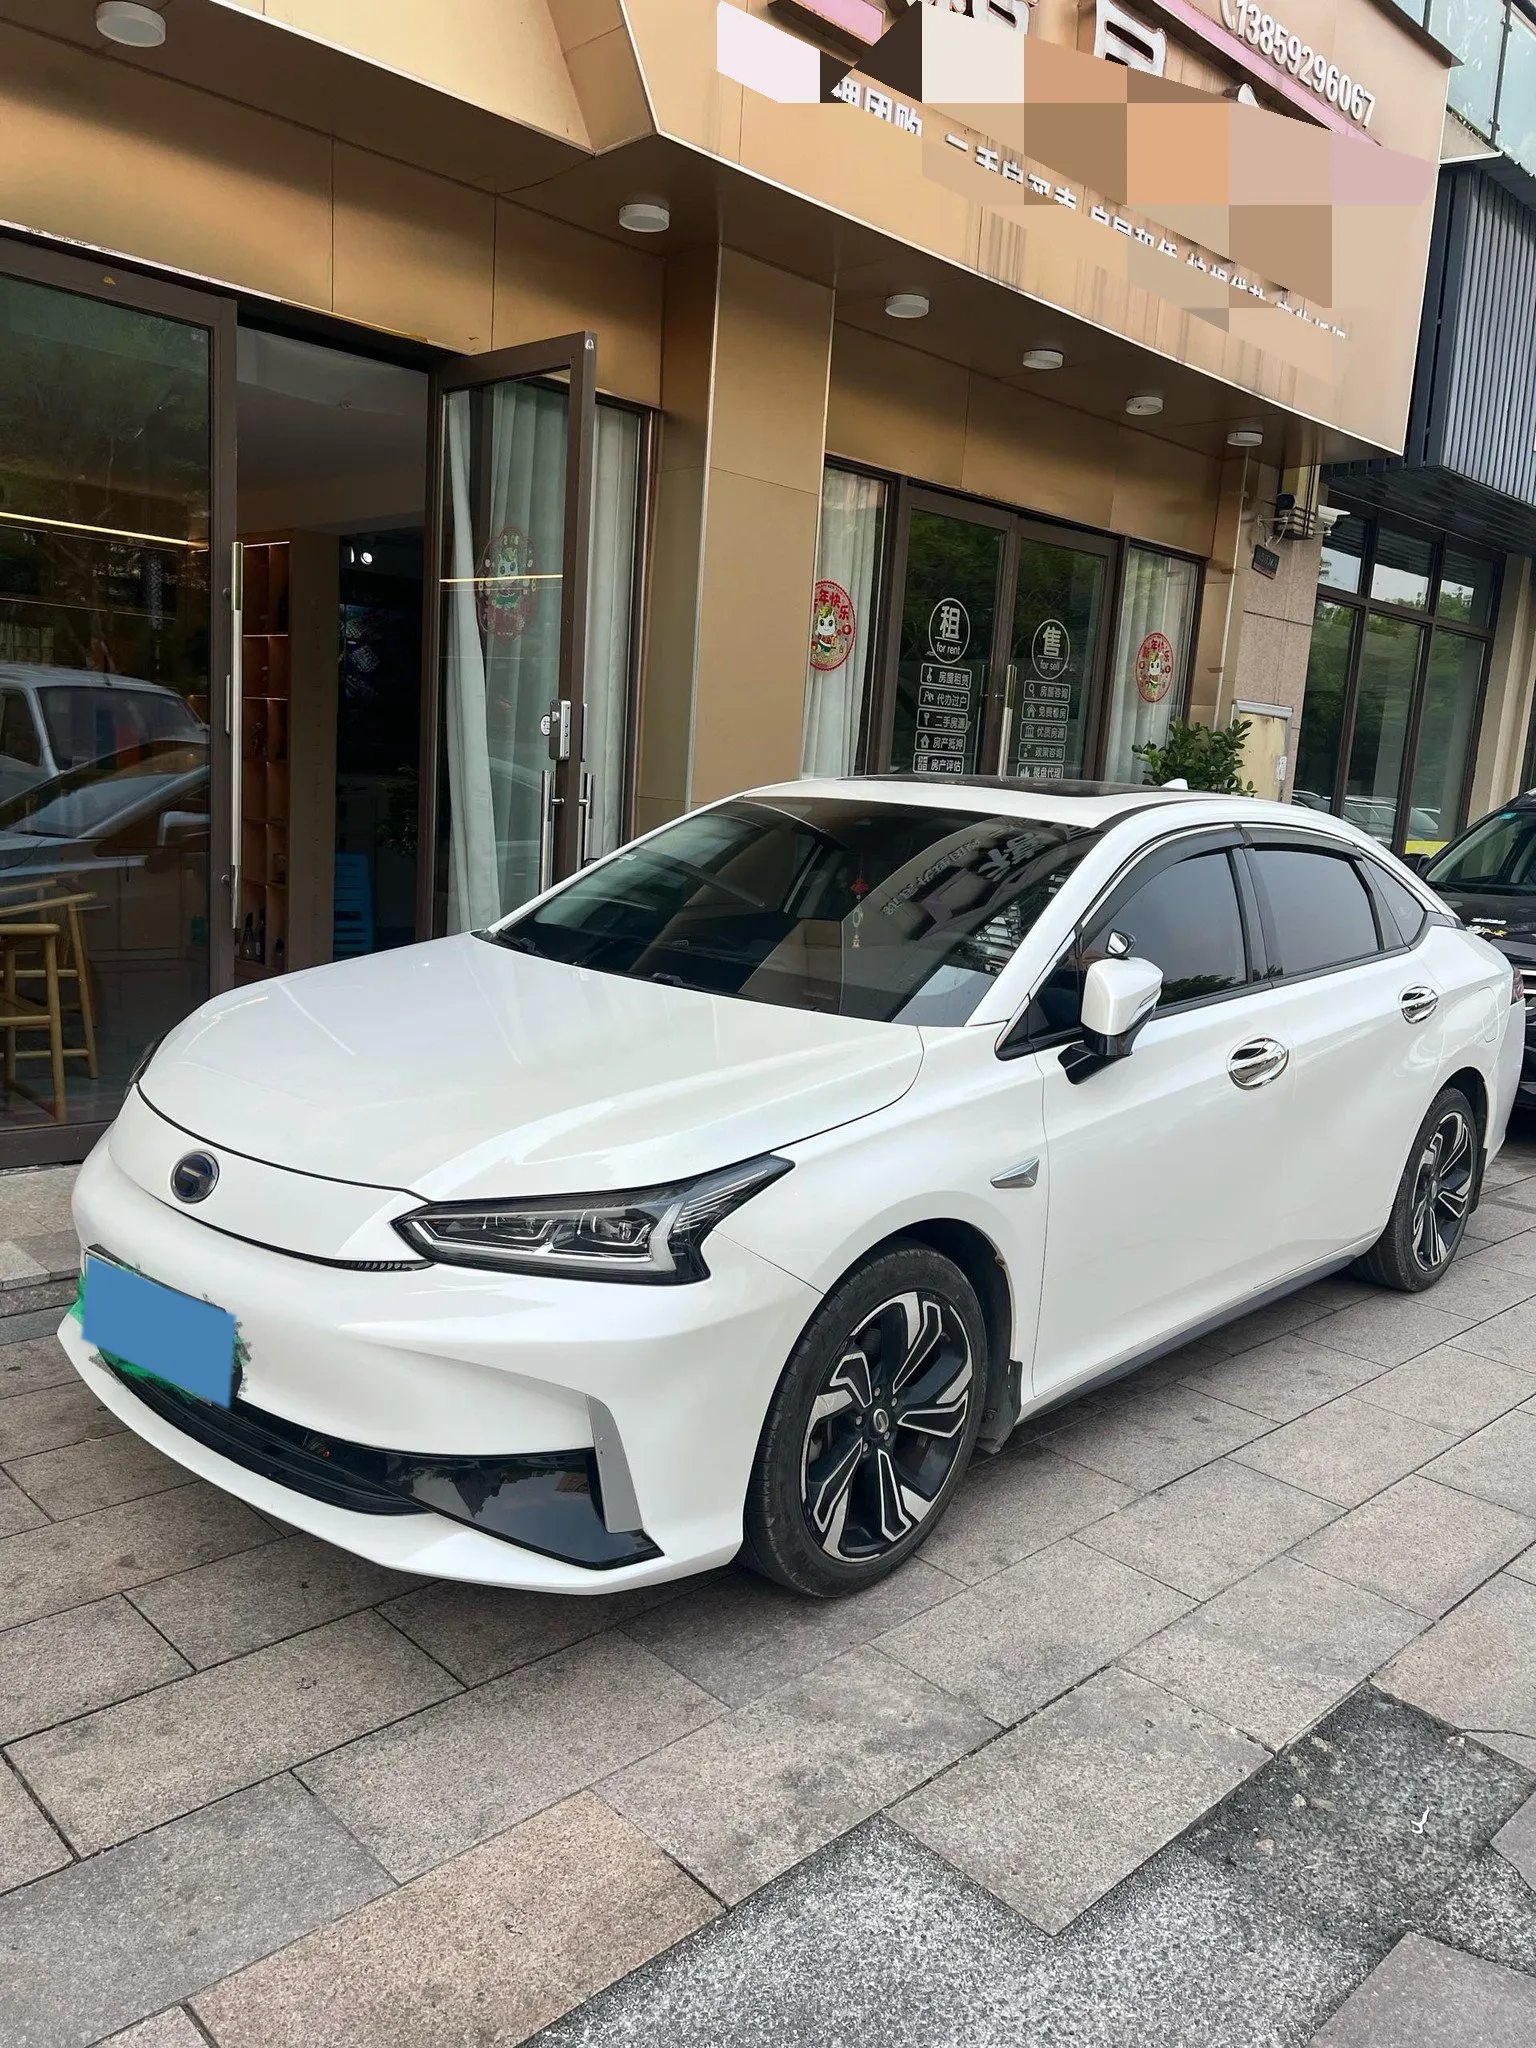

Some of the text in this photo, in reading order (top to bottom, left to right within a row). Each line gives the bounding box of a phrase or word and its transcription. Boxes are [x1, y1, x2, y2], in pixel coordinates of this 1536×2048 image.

[1236, 0, 1376, 128] 13859296067
[939, 605, 961, 640] 租
[936, 642, 961, 655] for rent
[1042, 626, 1061, 657] 售
[1040, 659, 1049, 670] for
[936, 693, 967, 707] 代办过户
[930, 758, 962, 772] 房产评估
